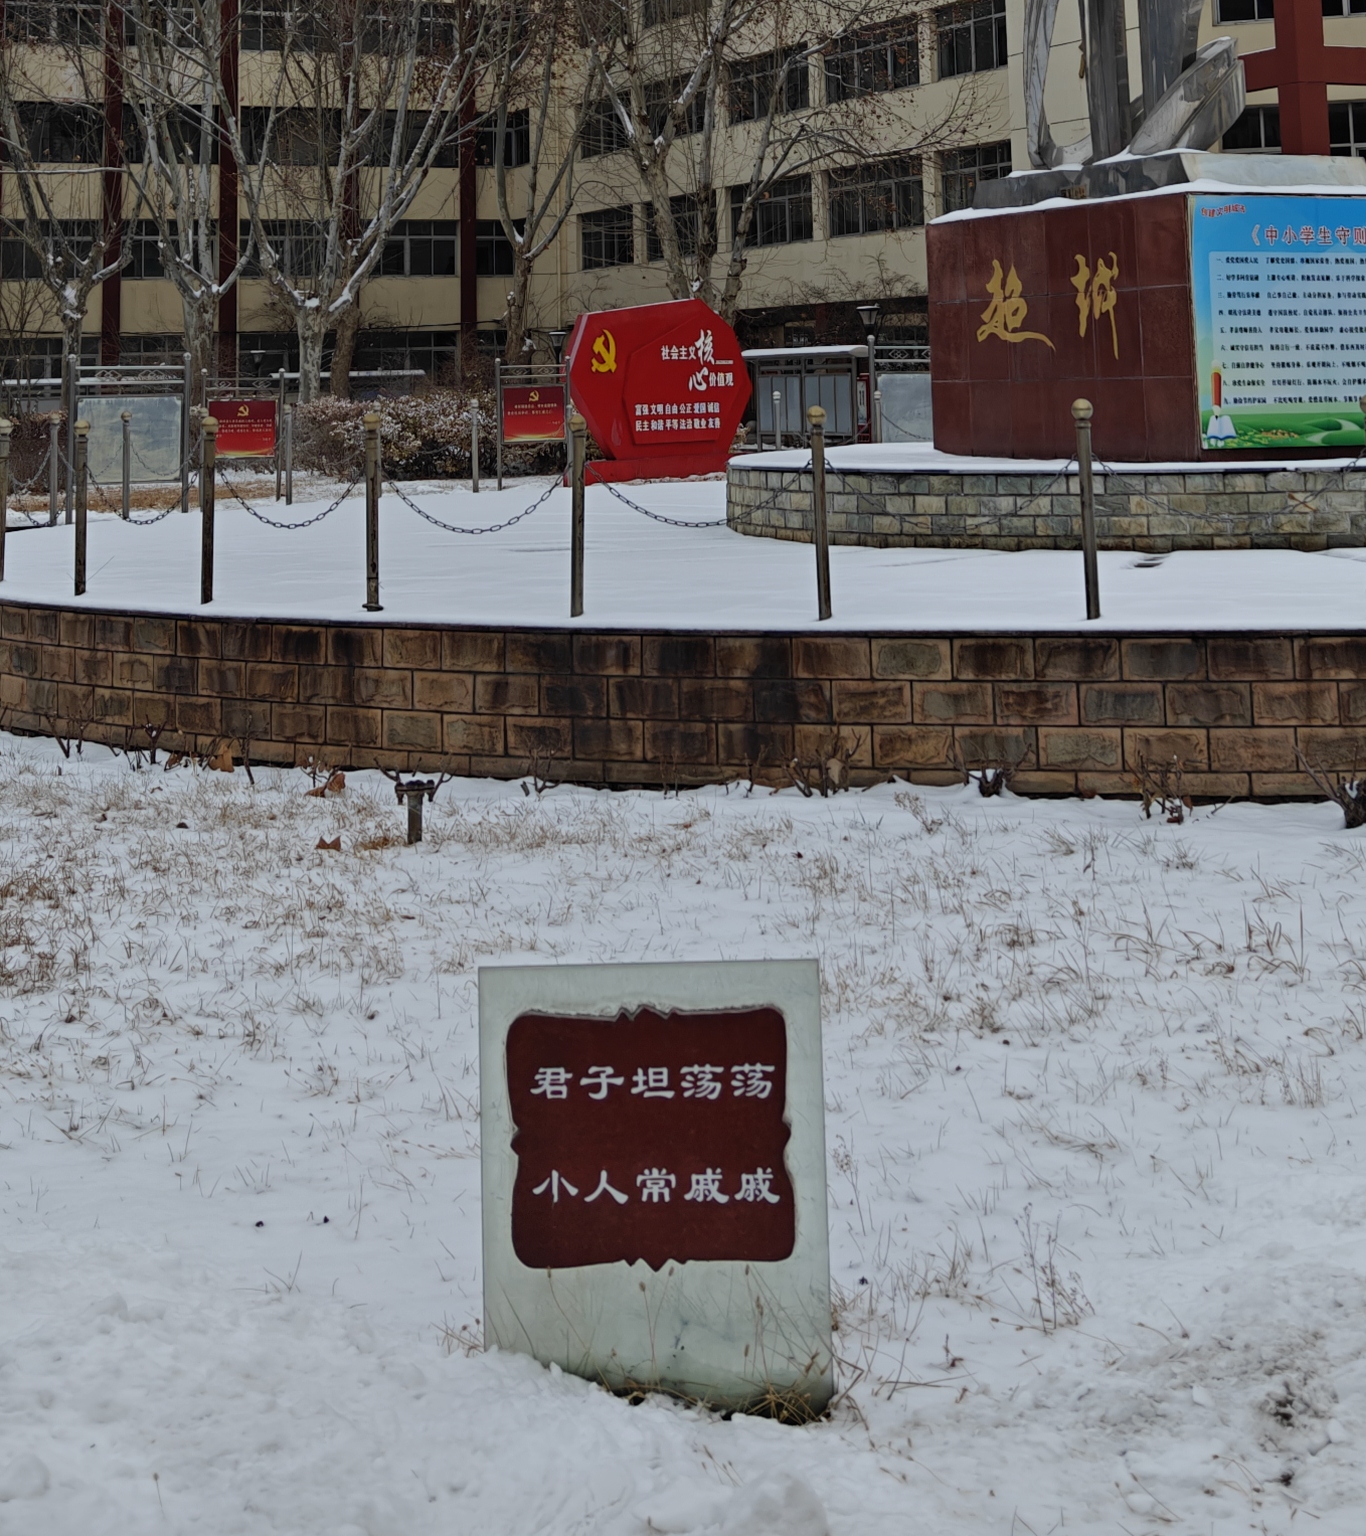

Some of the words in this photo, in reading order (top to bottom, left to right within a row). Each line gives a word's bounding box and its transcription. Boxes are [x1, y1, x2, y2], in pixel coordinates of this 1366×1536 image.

[689, 367, 734, 392] 心价值观
[530, 1063, 775, 1100] 君子坦荡荡
[532, 1166, 780, 1205] 小人常戚戚
